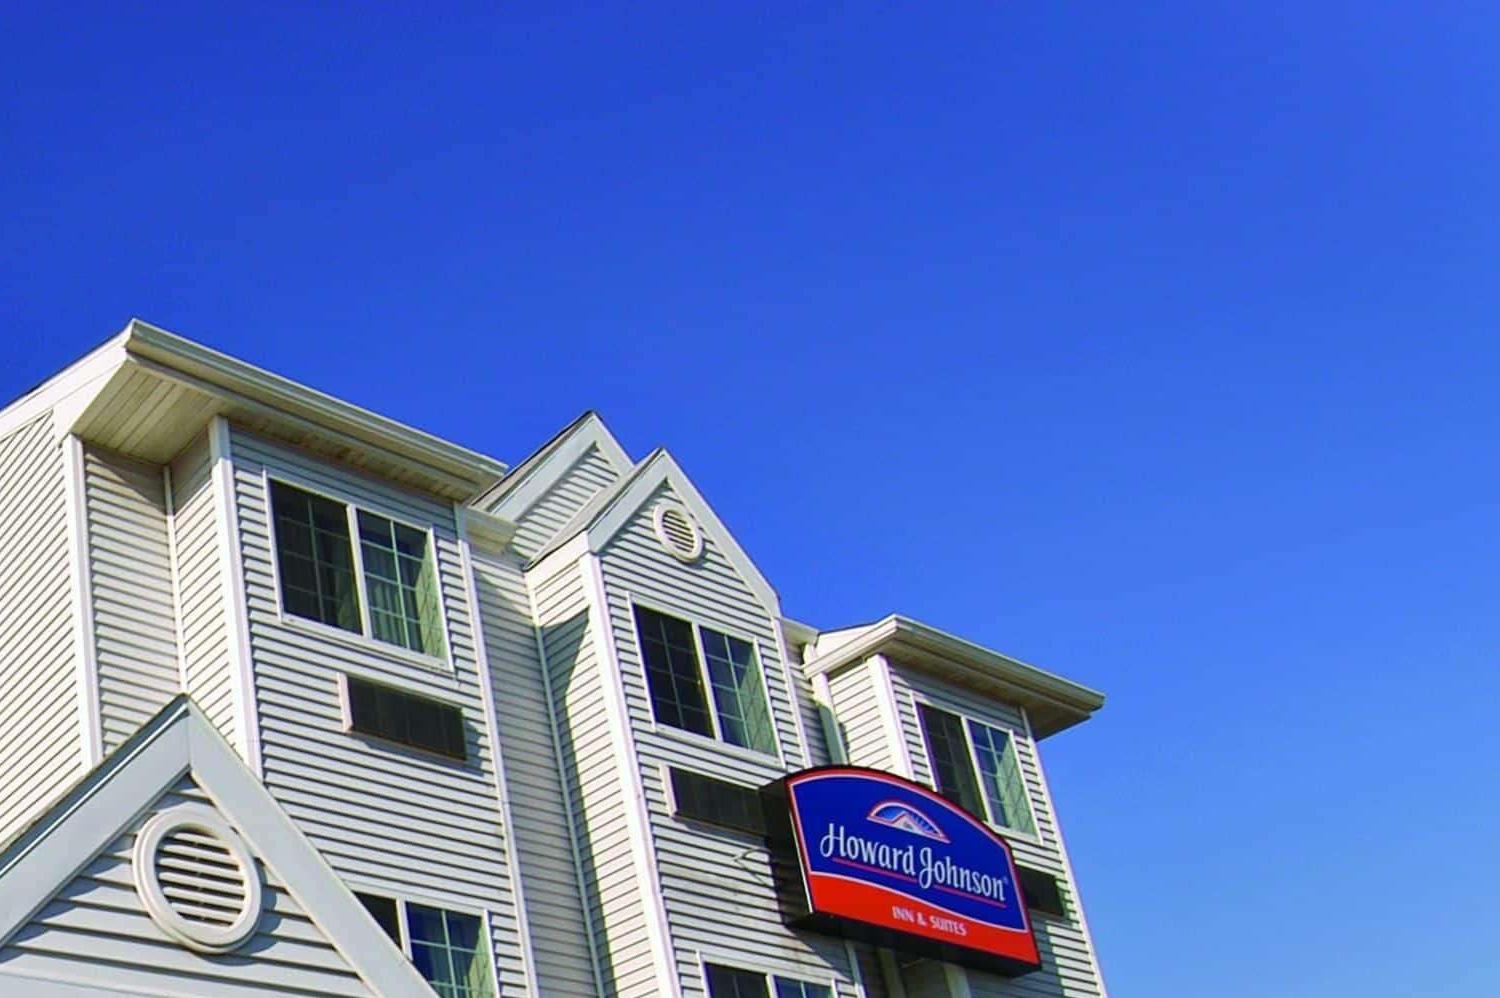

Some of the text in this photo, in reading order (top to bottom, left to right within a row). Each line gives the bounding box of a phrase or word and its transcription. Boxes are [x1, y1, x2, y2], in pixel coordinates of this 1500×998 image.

[819, 823, 1005, 901] Howard Johnson
[891, 905, 967, 936] INN & SUITES
